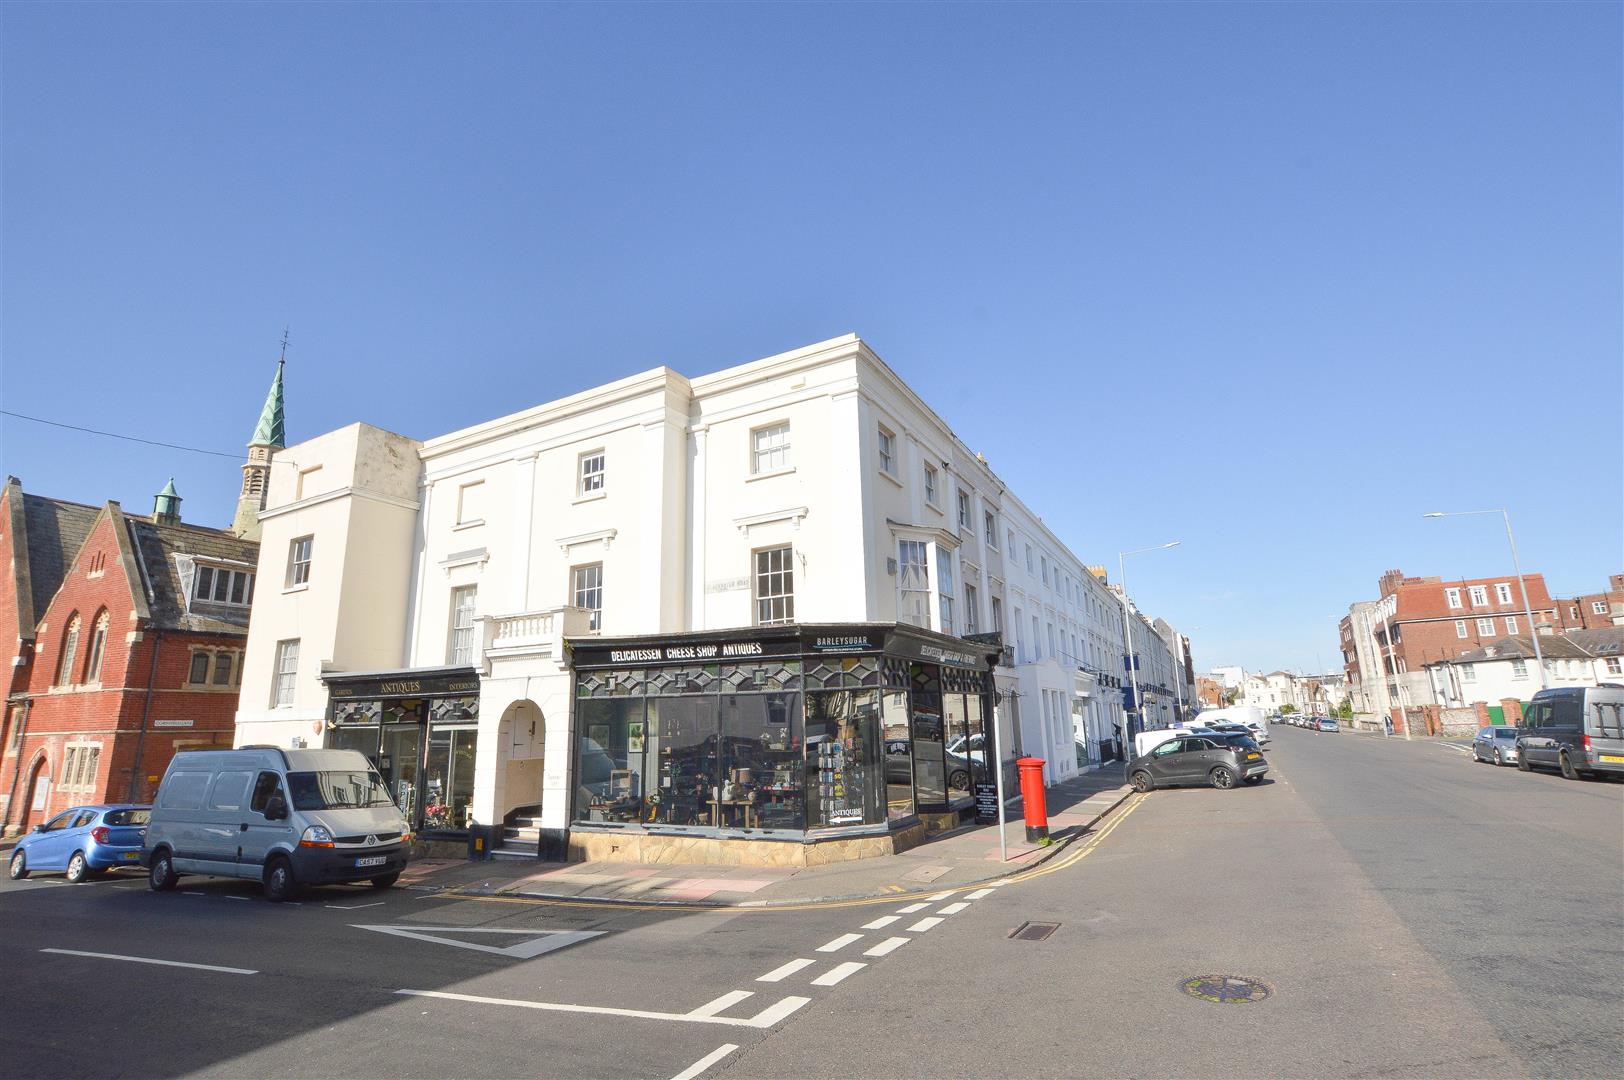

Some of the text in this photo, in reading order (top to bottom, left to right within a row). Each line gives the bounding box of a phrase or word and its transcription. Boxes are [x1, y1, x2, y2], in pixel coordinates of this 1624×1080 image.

[816, 636, 868, 646] BARLEYSUGAR
[611, 642, 762, 662] DELICATESSEN CHEESE SHOP ANTIQUES
[380, 681, 421, 693] ANTIQUES
[832, 807, 861, 817] ANTIQUES
